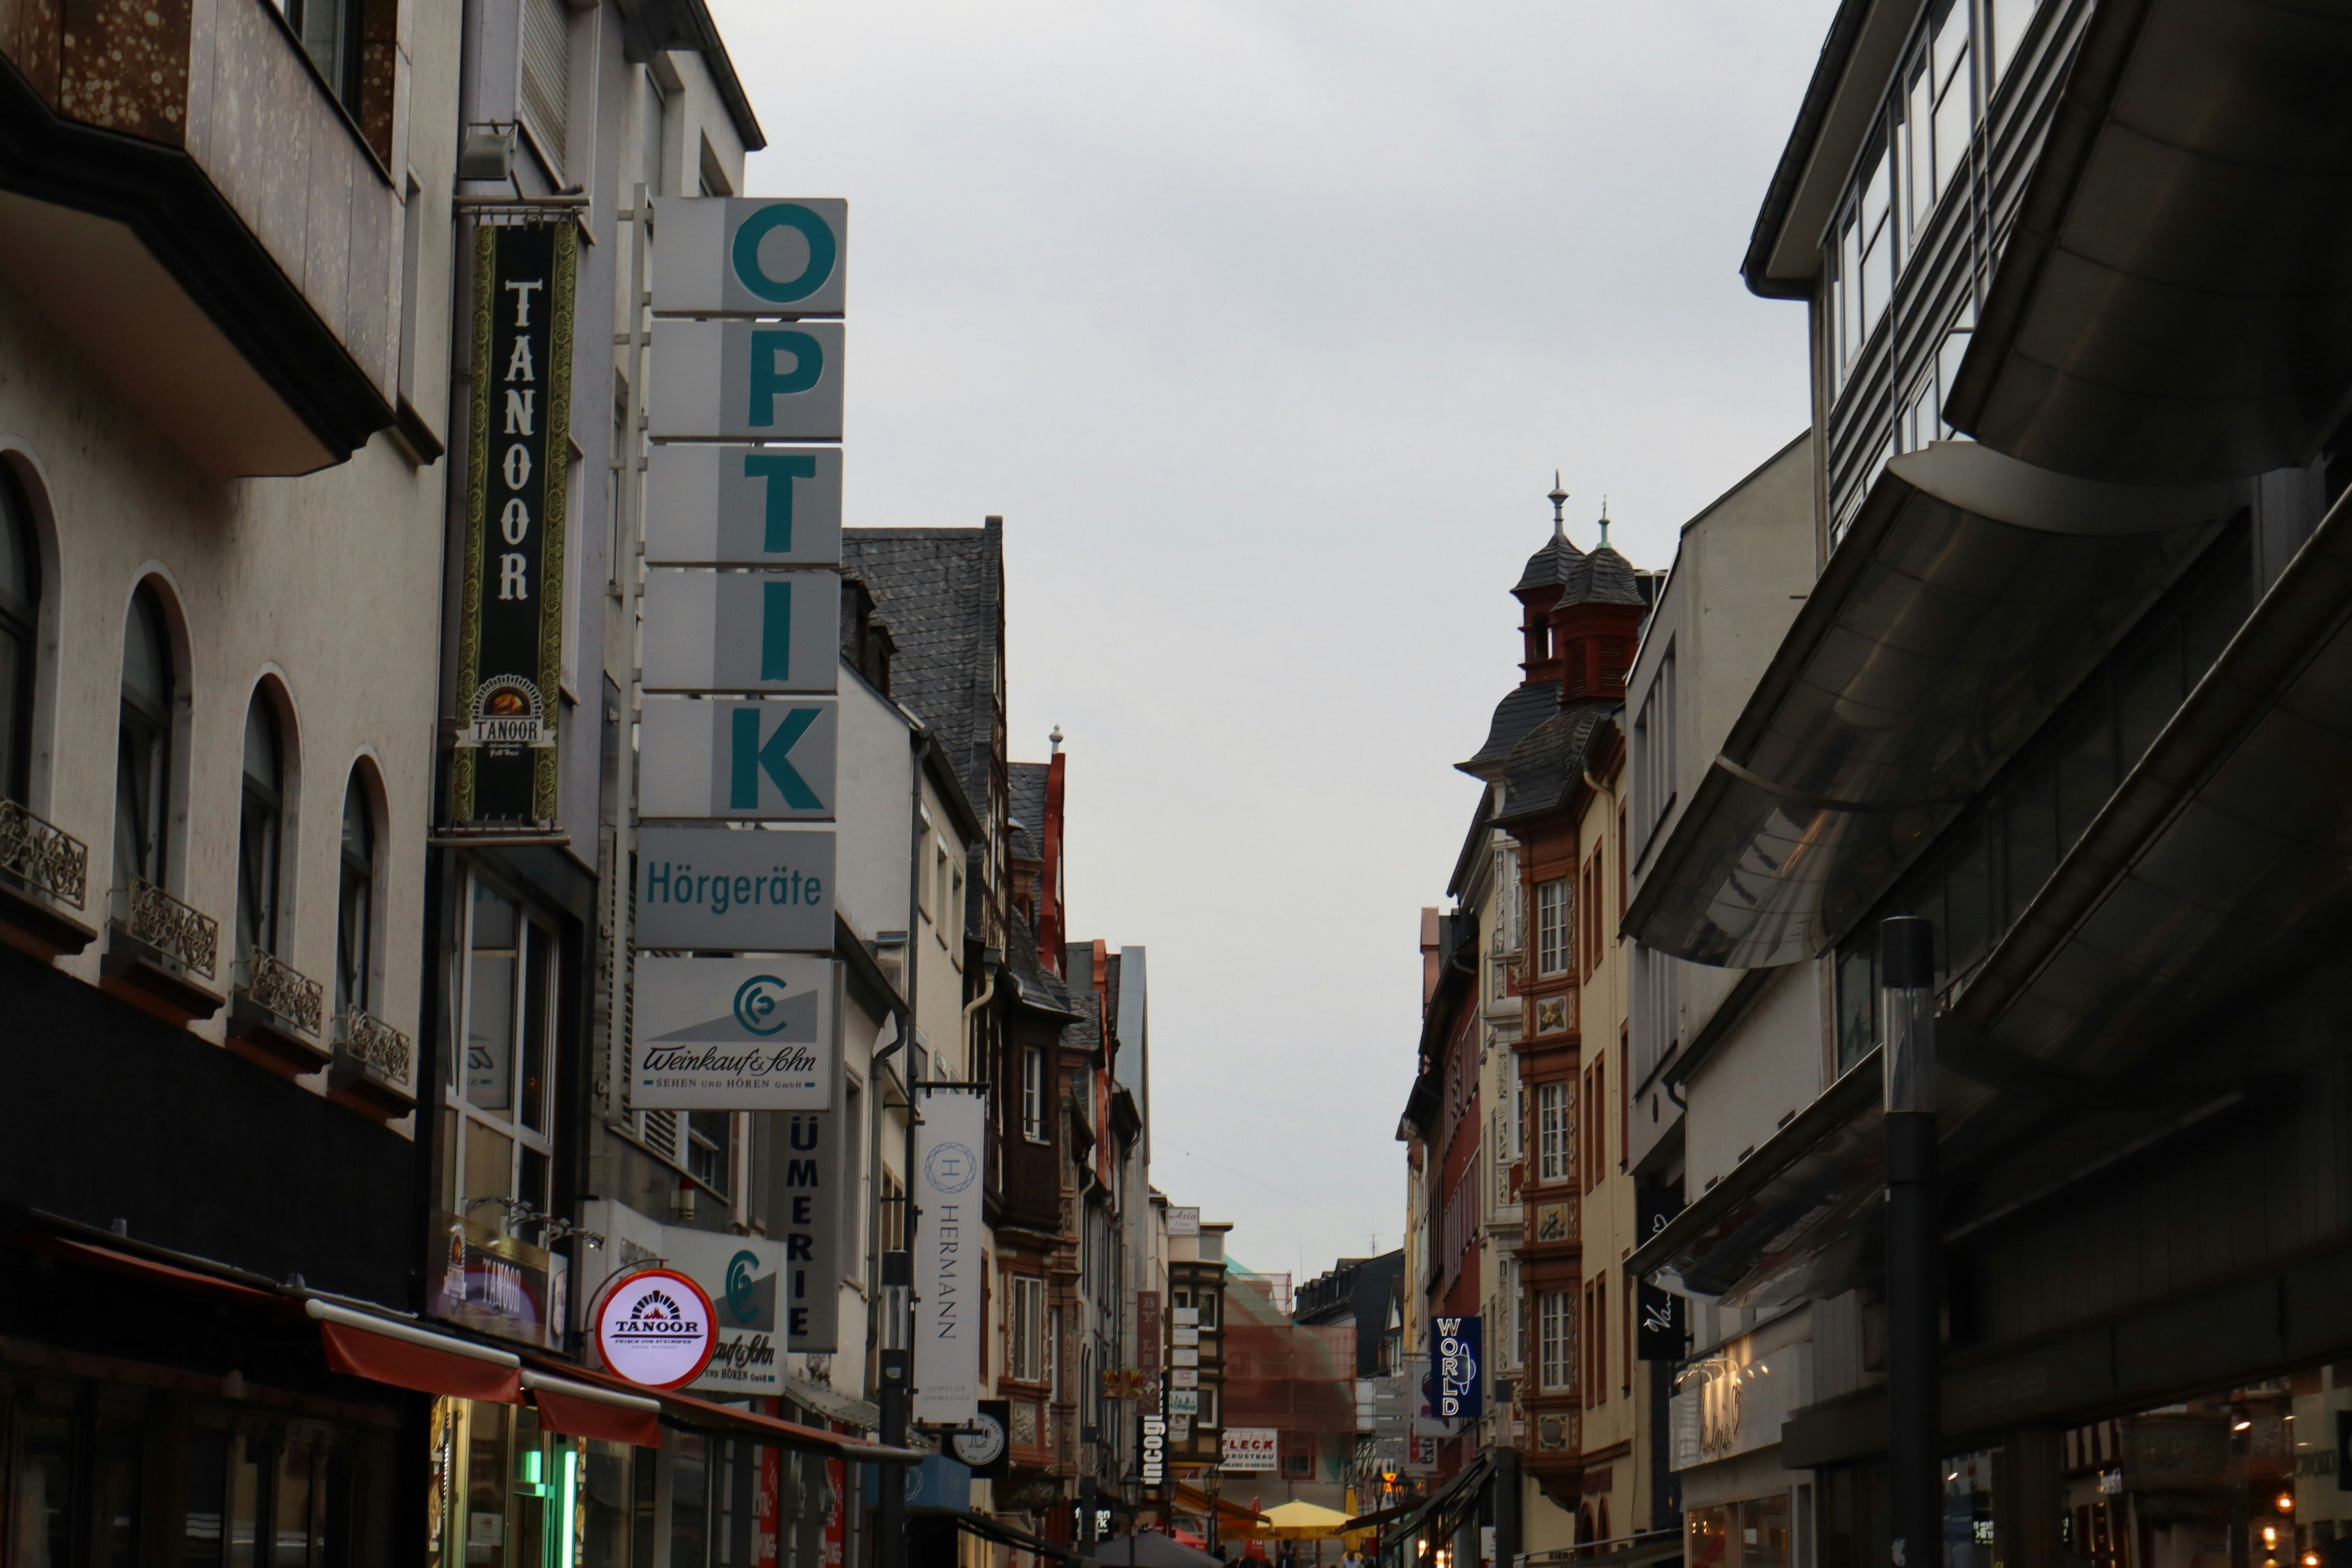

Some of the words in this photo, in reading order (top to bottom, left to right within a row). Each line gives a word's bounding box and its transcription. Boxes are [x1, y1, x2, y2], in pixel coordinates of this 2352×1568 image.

[497, 279, 543, 600] TANOOR
[730, 203, 836, 809] OPTIK
[474, 721, 537, 740] TANOOR
[647, 862, 821, 915] Hörgeräte
[643, 1045, 760, 1076] Weinkauf
[751, 1046, 816, 1076] Sohn
[656, 1078, 697, 1088] SEHEN
[727, 1078, 770, 1089] HÖREN
[786, 1116, 818, 1336] ÜMERIE
[1169, 1210, 1197, 1220] Asia
[938, 1205, 959, 1339] HERMANN
[615, 1321, 699, 1332] TANOOR
[721, 1367, 748, 1381] HÖREN
[1437, 1318, 1461, 1417] WORLD
[1140, 1379, 1166, 1485] incog
[1221, 1440, 1274, 1449] FLECK
